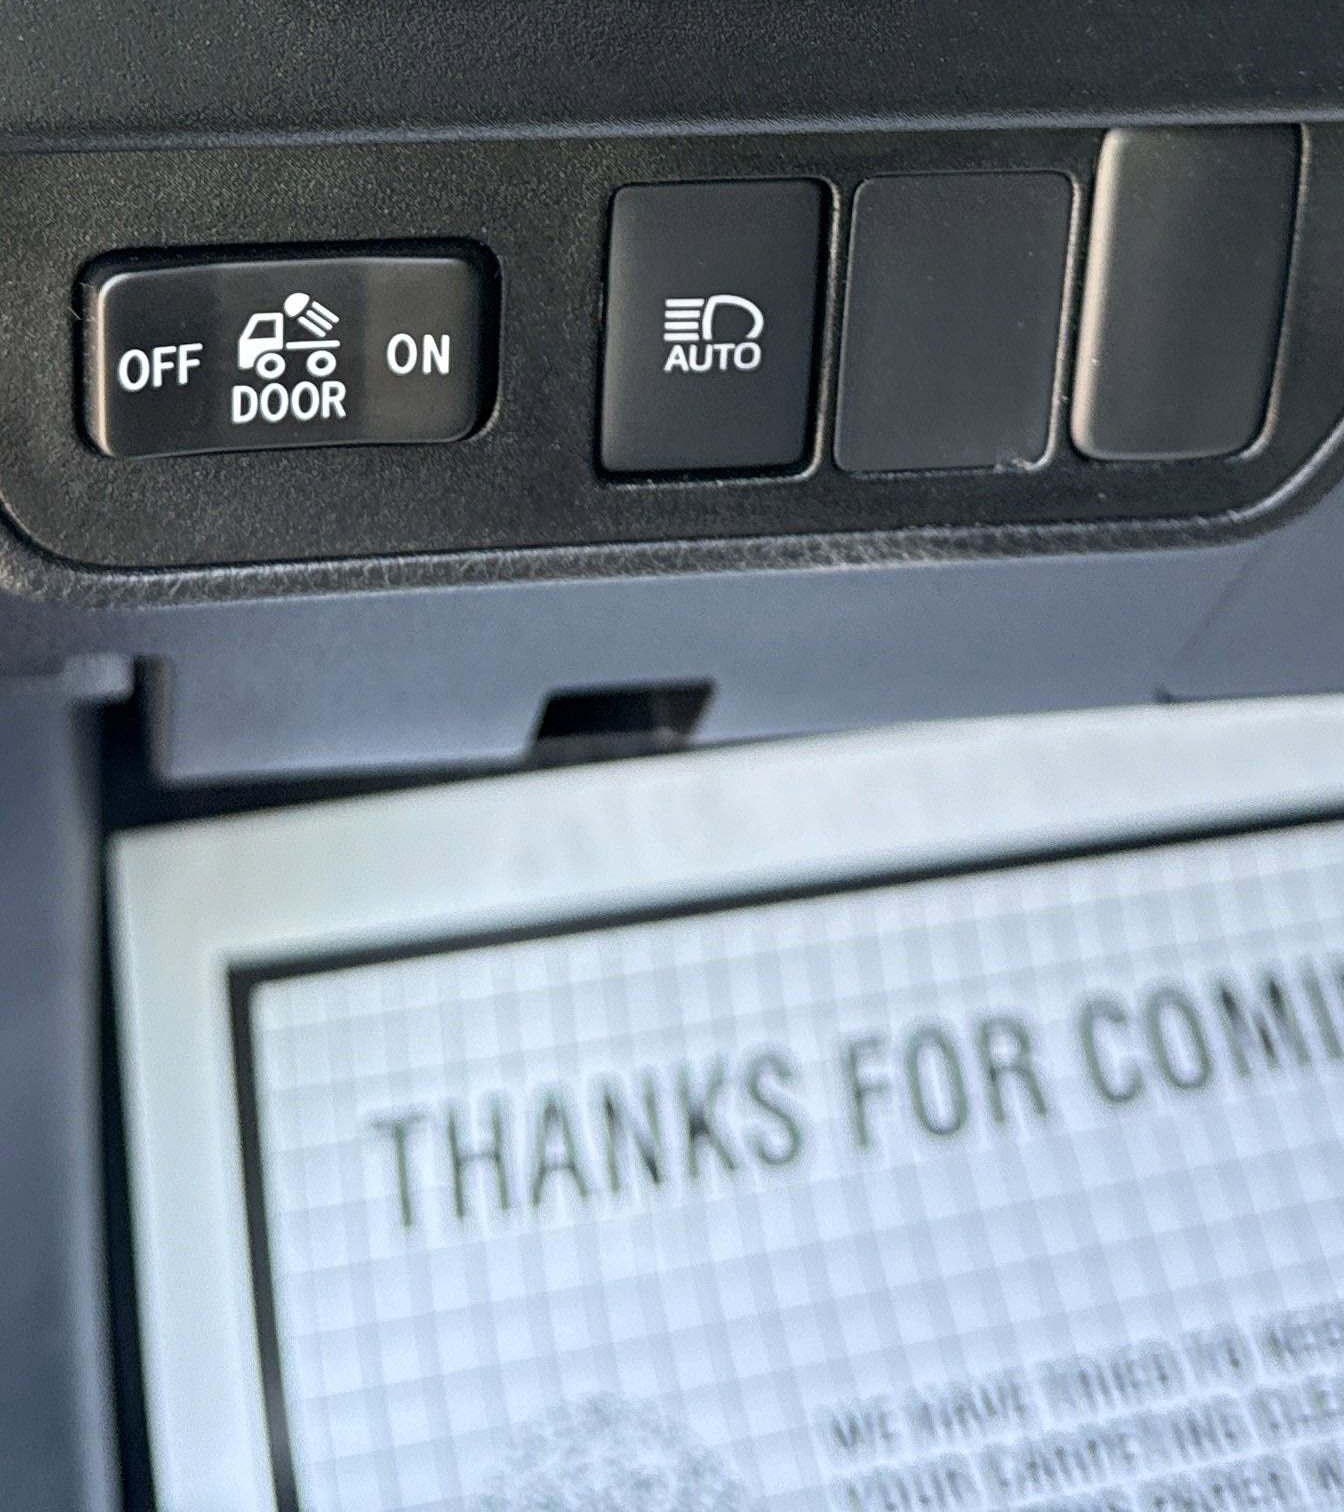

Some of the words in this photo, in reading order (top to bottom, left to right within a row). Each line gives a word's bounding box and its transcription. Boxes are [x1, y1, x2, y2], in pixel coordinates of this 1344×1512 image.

[117, 343, 204, 392] OFF
[385, 333, 452, 376] ON
[663, 341, 762, 373] AUTO
[231, 380, 347, 425] DOOR
[368, 1041, 804, 1230] THANKS
[834, 1010, 1050, 1154] FOR
